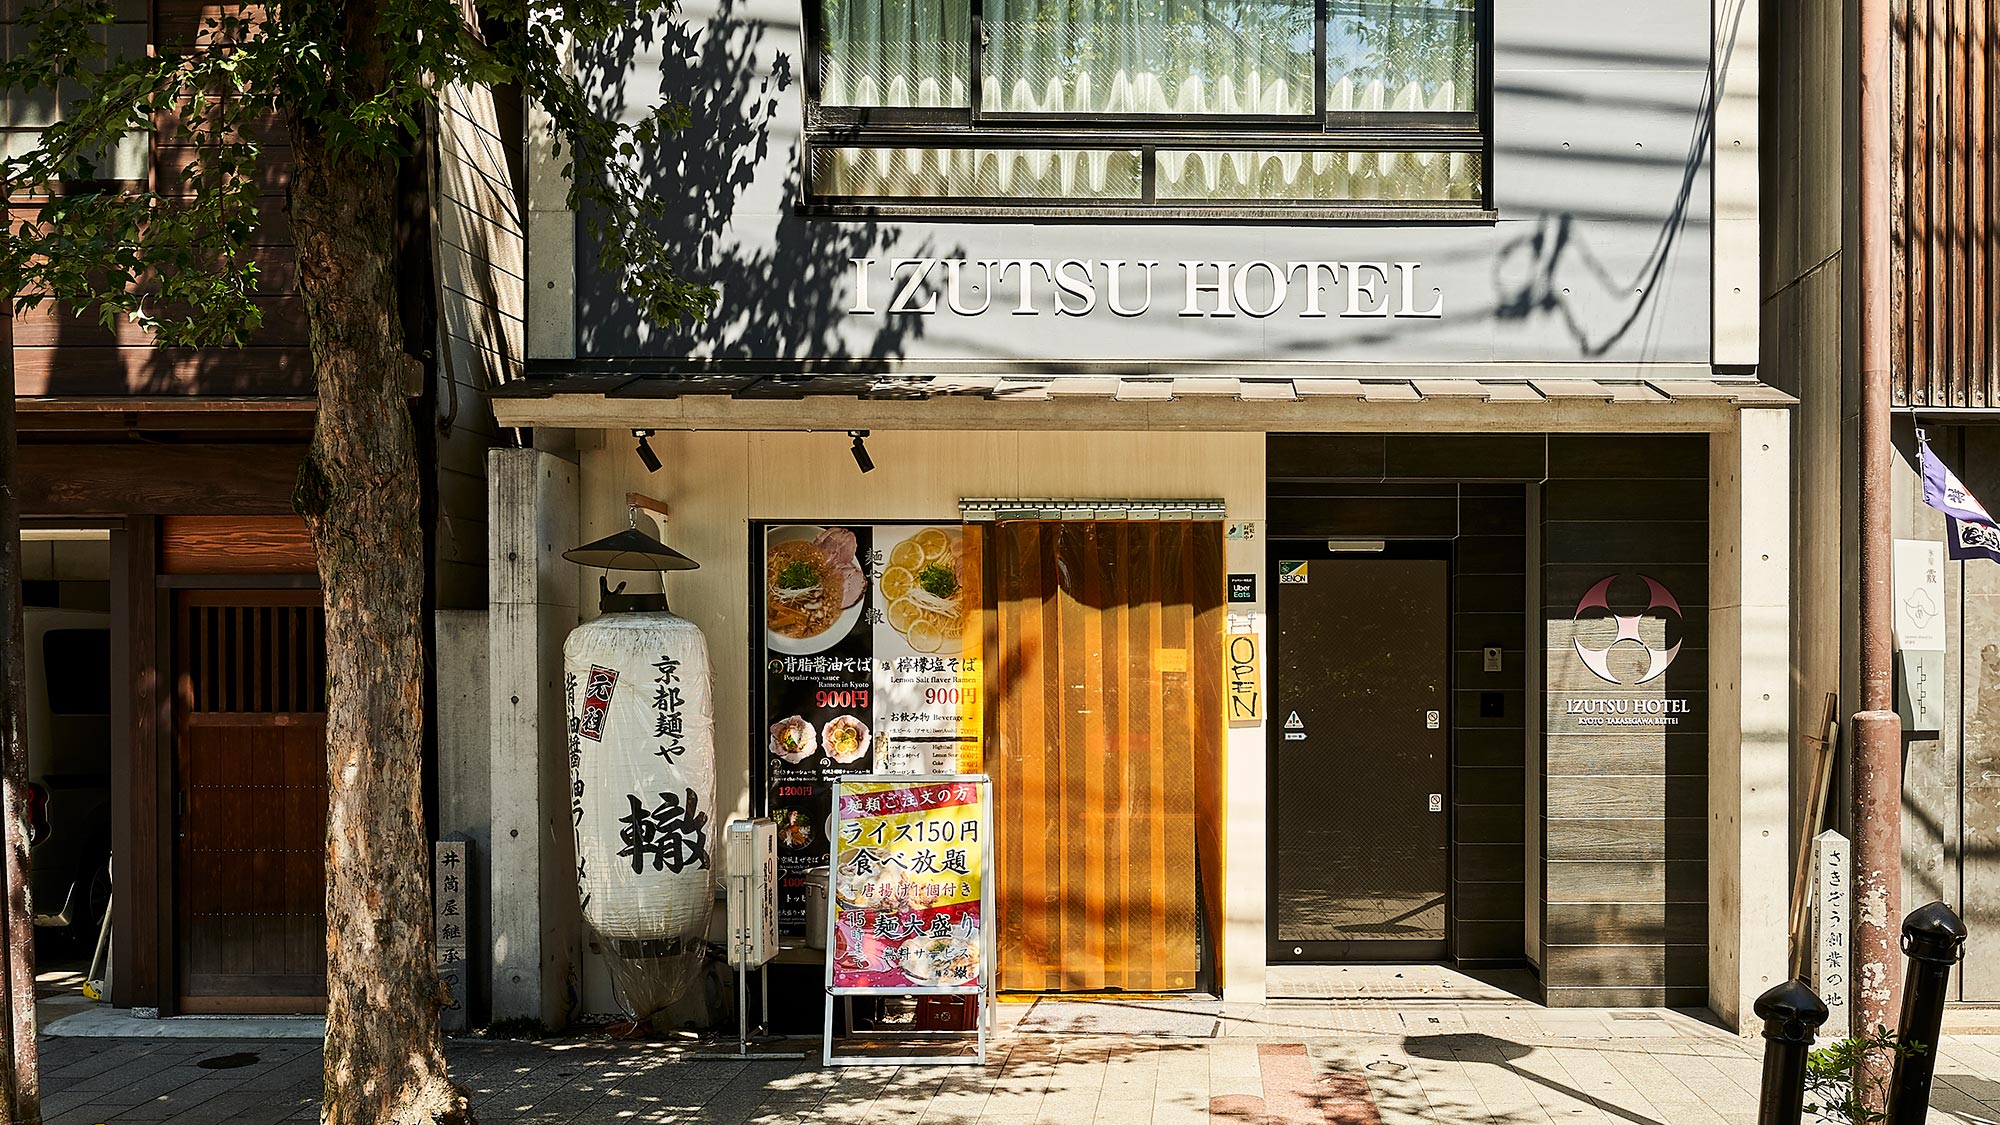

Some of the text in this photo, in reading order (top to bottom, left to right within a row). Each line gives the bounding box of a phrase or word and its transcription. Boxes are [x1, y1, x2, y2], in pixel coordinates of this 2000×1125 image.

[848, 257, 1444, 319] IZUTSU HOTEL
[1281, 575, 1306, 583] SENON
[783, 655, 872, 674] 背脂醤油そば
[783, 674, 809, 682] Popular
[850, 681, 870, 689] Kyoto
[1230, 636, 1258, 718] OPEN
[581, 673, 614, 734] 元祖
[816, 689, 869, 708] 900円
[925, 687, 977, 705] 900円
[1566, 699, 1690, 714] IZUTSU HOTEL
[890, 712, 930, 722] お飲み物
[1578, 717, 1605, 726] KYOTO
[616, 655, 710, 875] 京都麺や 轍
[778, 786, 813, 797] 1200円
[847, 785, 970, 814] 麺類ご注文の方
[842, 819, 978, 845] ライス150円
[848, 848, 970, 877] 食べ放題
[874, 912, 974, 940] 麺大盛り
[883, 946, 969, 962] 無料サービス
